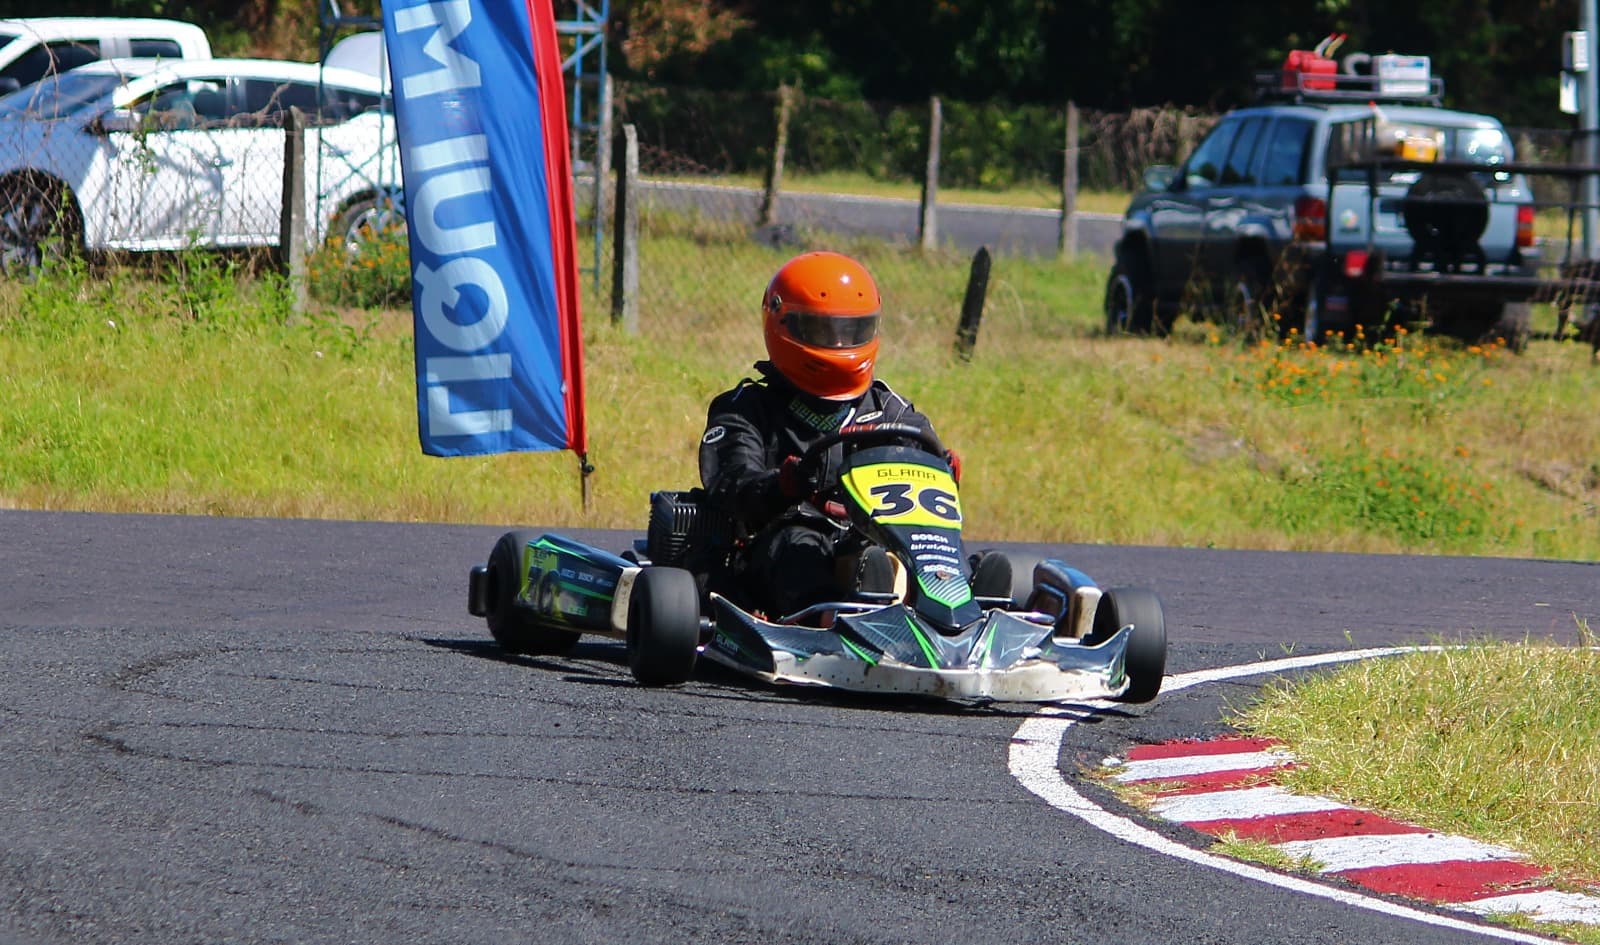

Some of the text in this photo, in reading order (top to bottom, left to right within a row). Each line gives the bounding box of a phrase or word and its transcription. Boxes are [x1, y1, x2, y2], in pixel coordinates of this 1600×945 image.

[877, 468, 936, 481] GLAMA
[870, 483, 962, 521] 36
[911, 533, 949, 544] BOSCH
